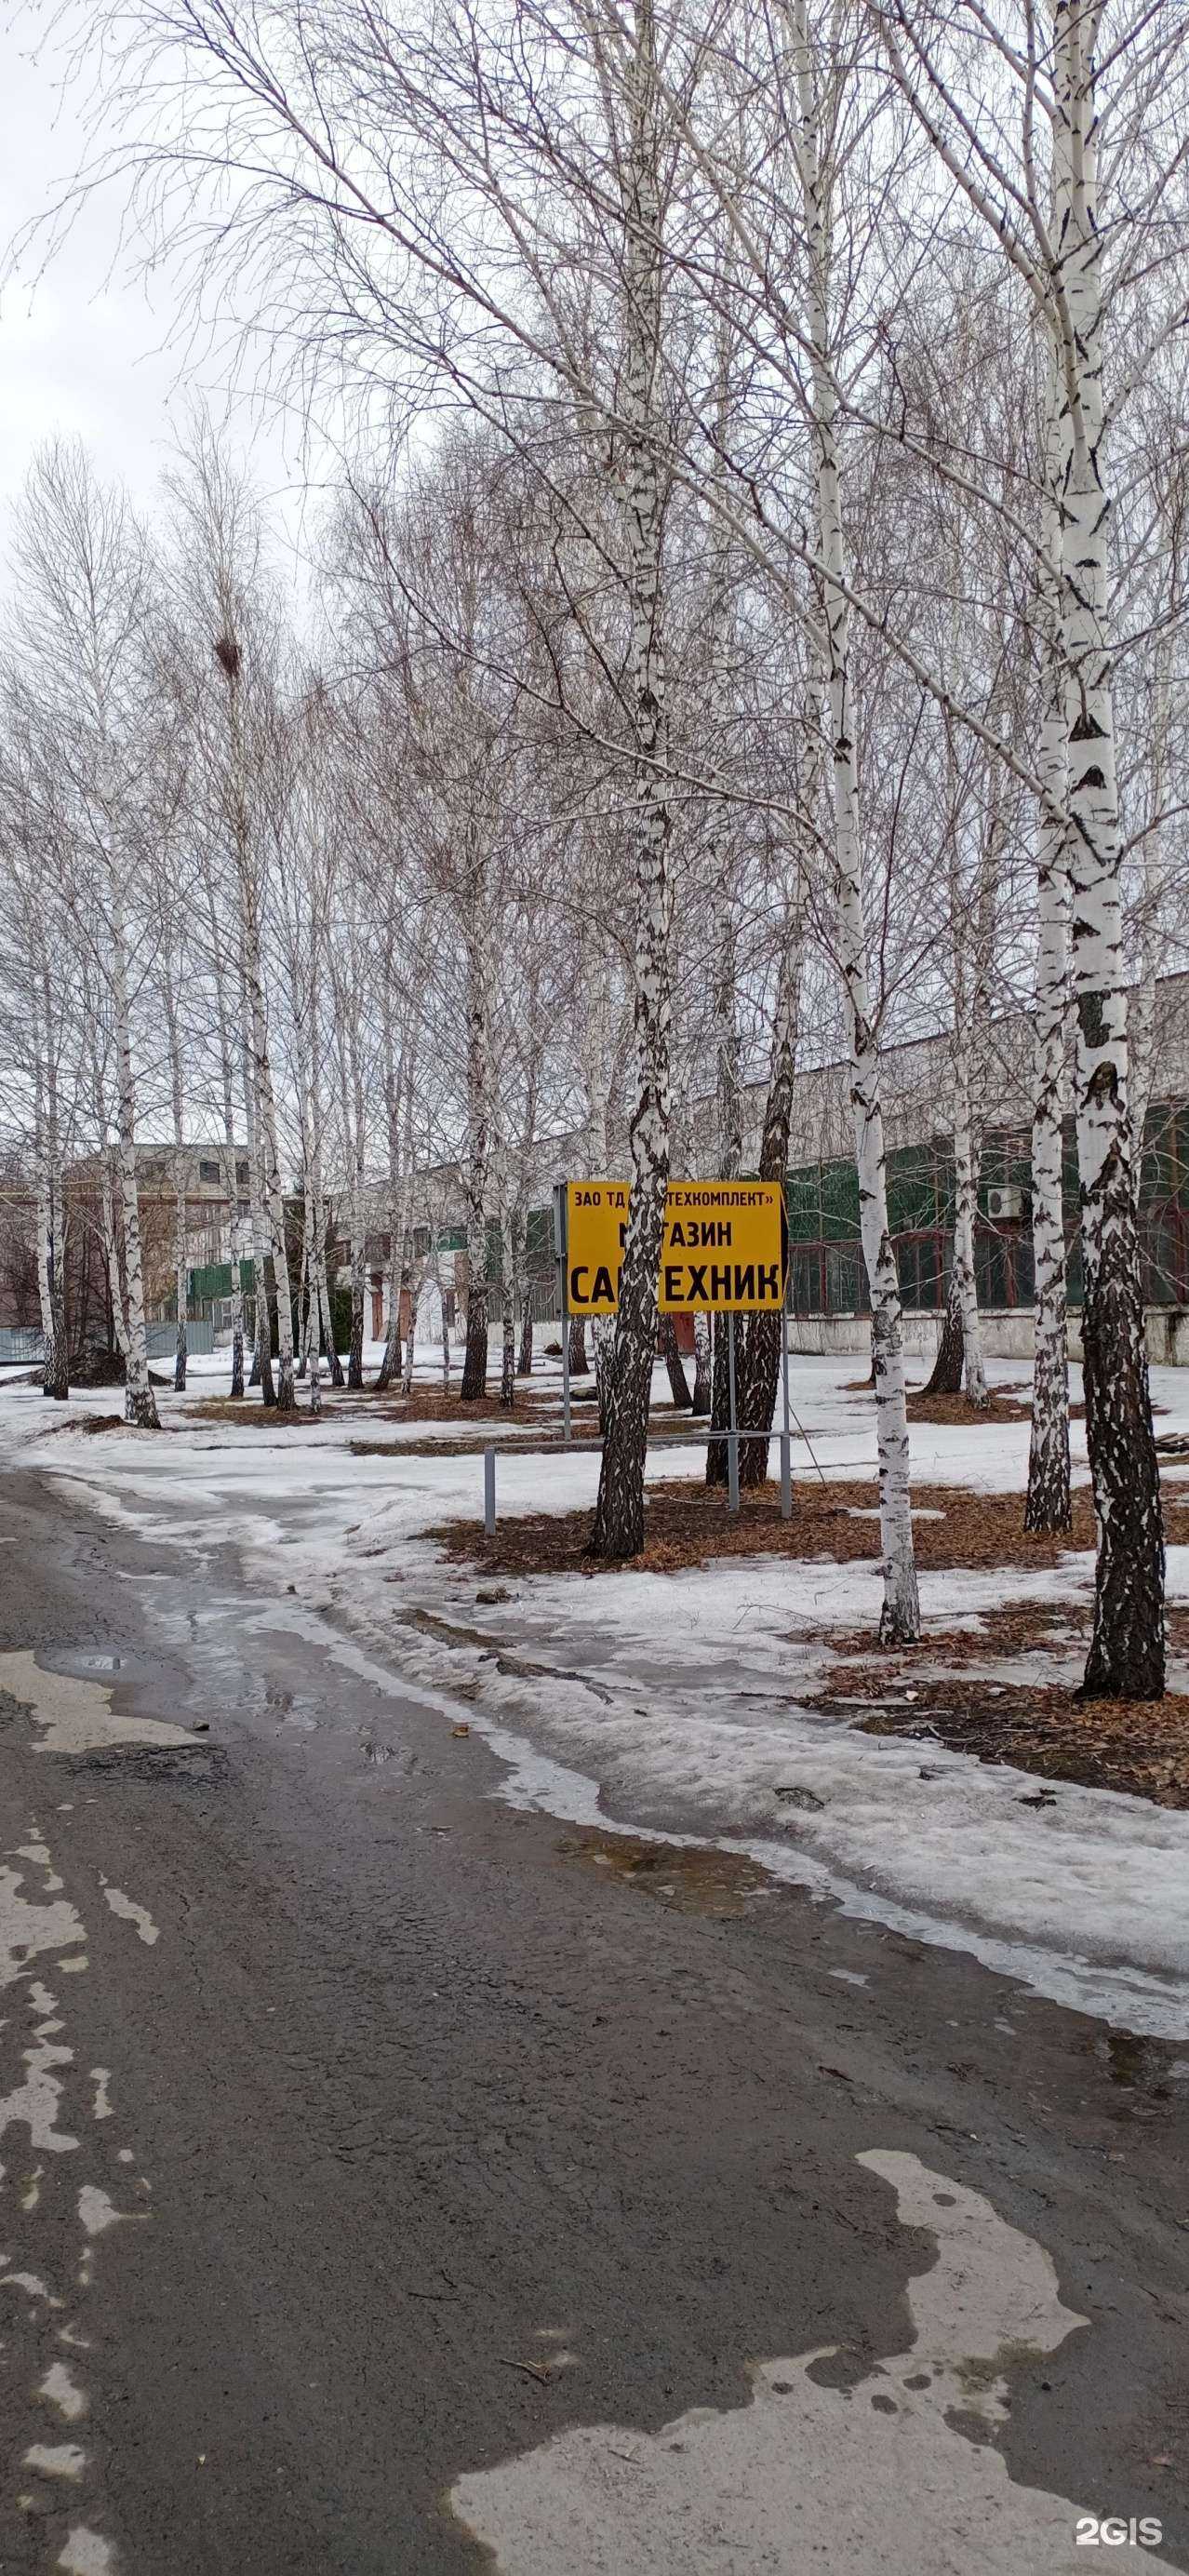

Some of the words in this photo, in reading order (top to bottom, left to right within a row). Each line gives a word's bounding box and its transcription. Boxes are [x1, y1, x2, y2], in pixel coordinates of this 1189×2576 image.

[575, 1192, 601, 1206] ЗАО
[607, 1192, 625, 1208] ТД
[666, 1191, 774, 1206] ТЕХКОМПЛЕКТ»
[570, 1264, 780, 1303] САЕХНИК
